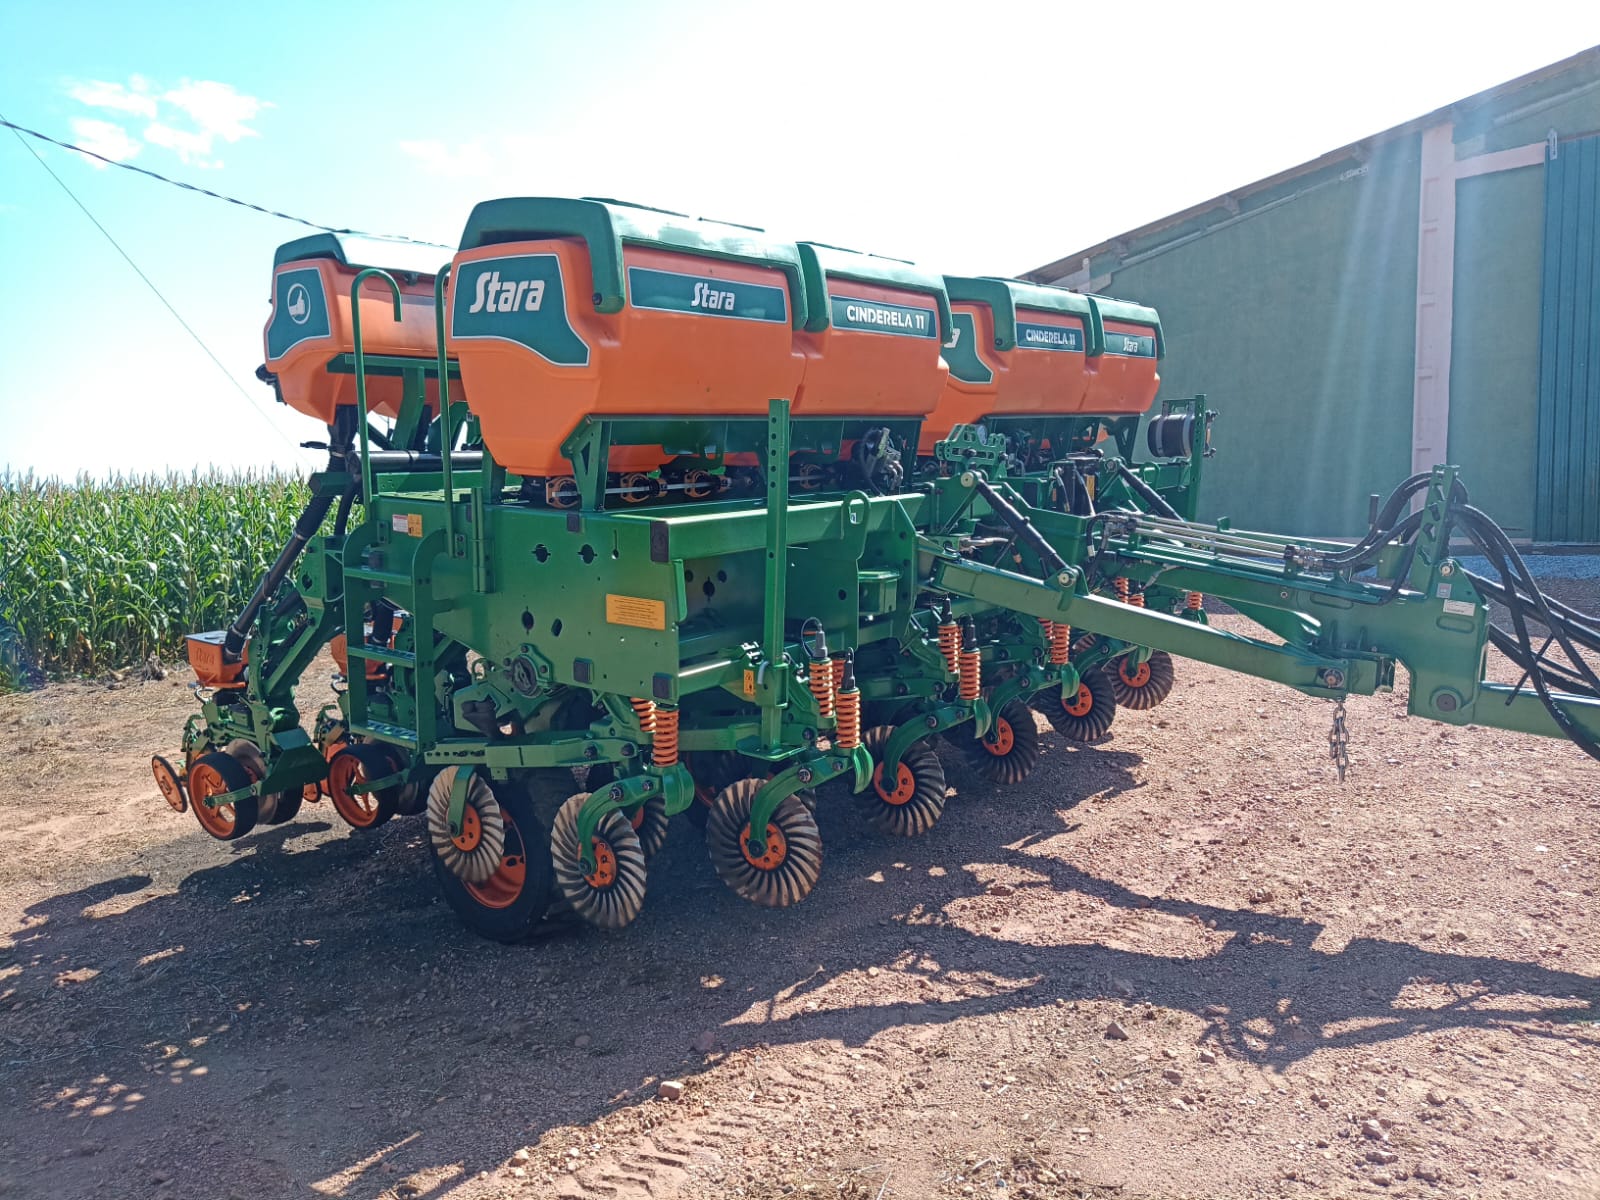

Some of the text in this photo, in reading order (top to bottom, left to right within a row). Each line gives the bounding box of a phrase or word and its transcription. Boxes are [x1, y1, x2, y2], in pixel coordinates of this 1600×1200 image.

[469, 271, 545, 313] Stara
[691, 282, 735, 310] Stara
[846, 305, 925, 330] CINDERELA 11
[1025, 328, 1076, 345] CINDERELA 11
[1123, 337, 1138, 353] Stara
